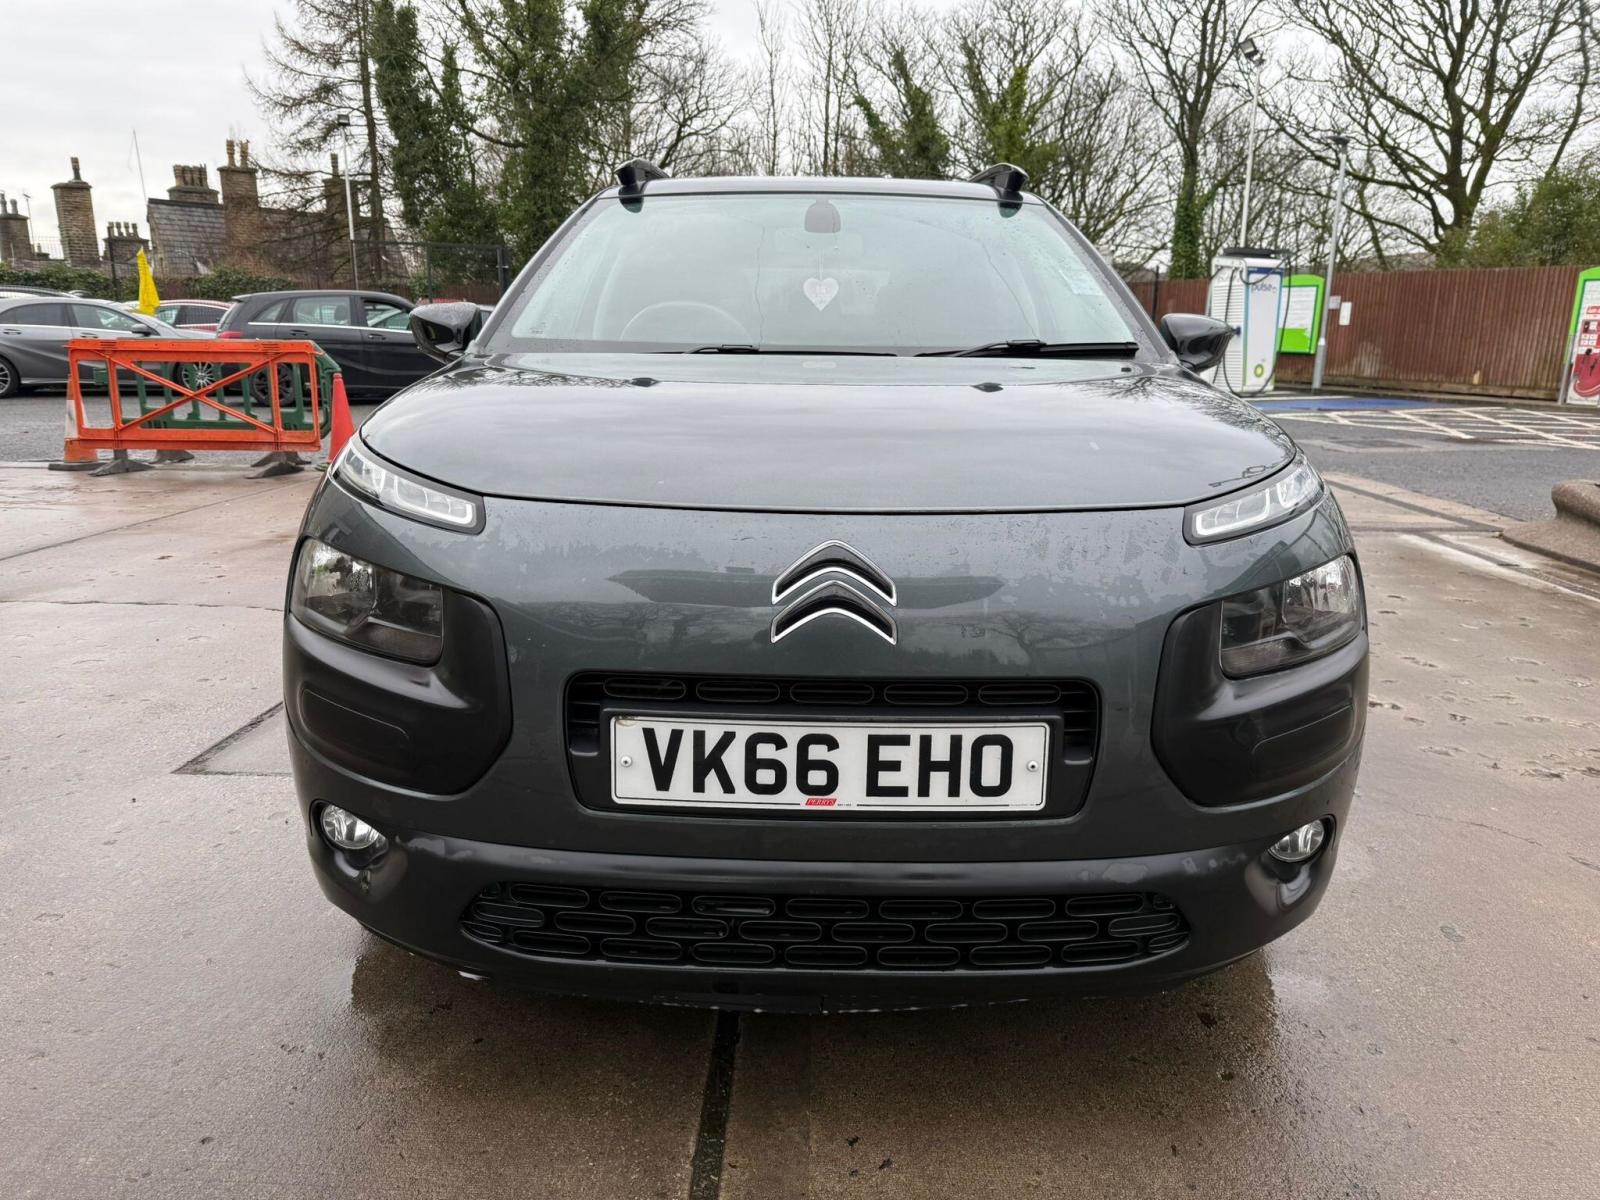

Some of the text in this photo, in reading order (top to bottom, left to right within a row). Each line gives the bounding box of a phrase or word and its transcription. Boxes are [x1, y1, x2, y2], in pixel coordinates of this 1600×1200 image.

[642, 727, 1014, 798] VK66 EHO
[807, 798, 836, 806] PERRYS
